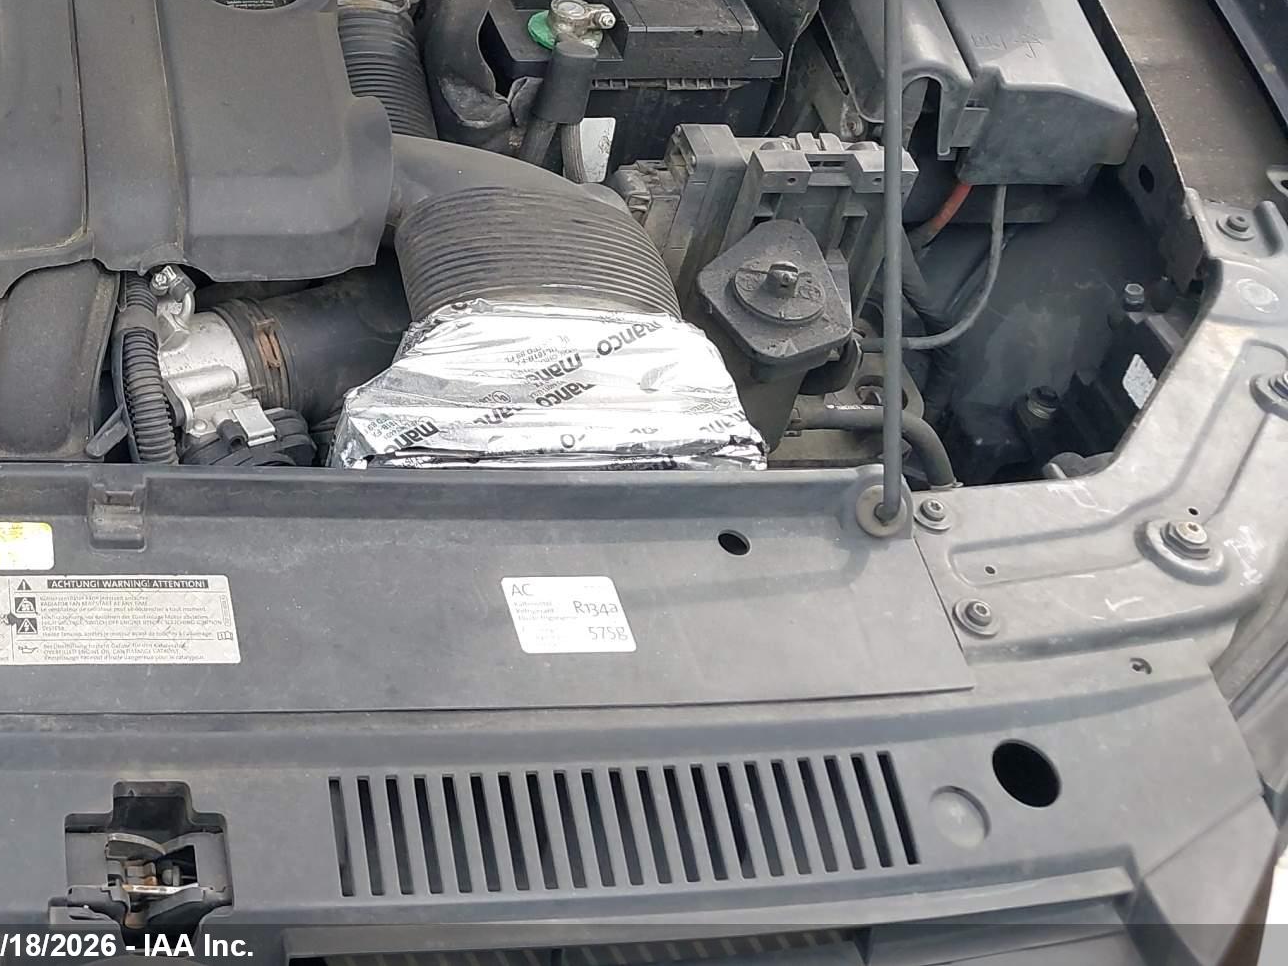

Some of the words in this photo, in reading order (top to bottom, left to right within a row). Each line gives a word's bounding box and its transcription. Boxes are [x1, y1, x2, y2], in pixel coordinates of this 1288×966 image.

[50, 580, 100, 588] ACHTUNG!
[103, 580, 151, 588] WARNING!
[152, 580, 206, 588] ATTENTION!
[511, 583, 534, 597] AC
[573, 600, 618, 617] R134a
